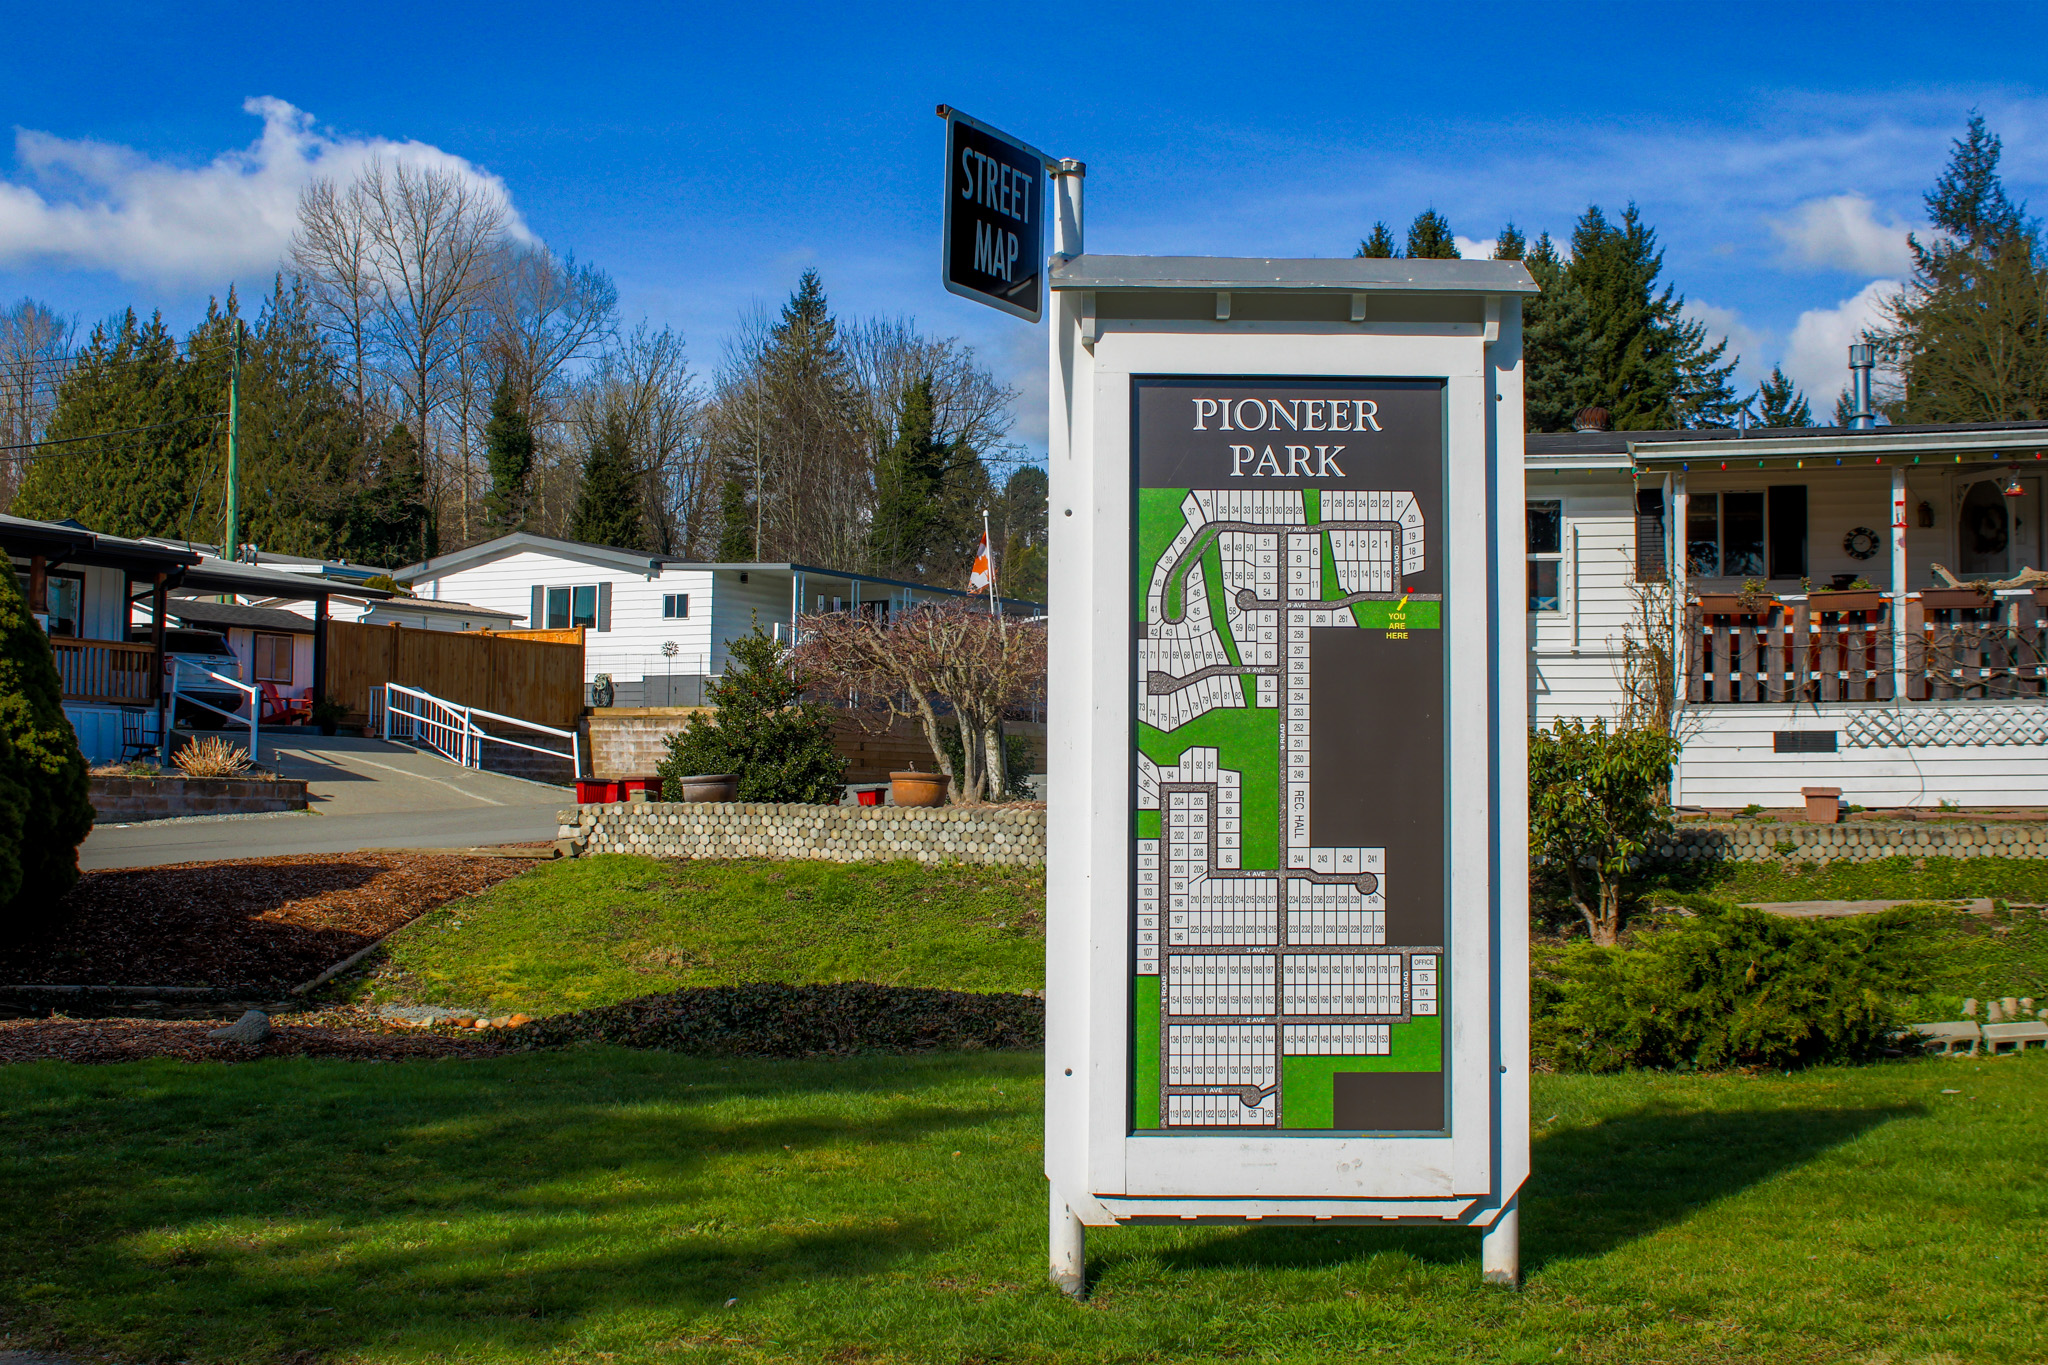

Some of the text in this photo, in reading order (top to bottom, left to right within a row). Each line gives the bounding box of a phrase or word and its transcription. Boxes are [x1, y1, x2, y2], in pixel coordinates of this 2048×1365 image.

[961, 146, 1033, 224] STREET
[973, 219, 1019, 283] MAP
[1192, 398, 1383, 432] PIONEER
[1228, 444, 1346, 478] PARK
[1202, 499, 1210, 507] 36
[1322, 500, 1330, 508] 27
[1334, 500, 1342, 508] 26
[1347, 500, 1354, 508] 25
[1370, 500, 1378, 508] 23
[1382, 500, 1390, 508] 22
[1396, 500, 1403, 508] 21
[1220, 506, 1227, 514] 35
[1231, 506, 1239, 514] 34
[1255, 506, 1263, 514] 32
[1265, 506, 1272, 514] 31
[1275, 506, 1282, 514] 30
[1409, 532, 1416, 540] 19
[1223, 544, 1231, 552] 48
[1246, 544, 1254, 552] 50
[1409, 547, 1416, 555] 18
[1165, 556, 1173, 564] 39
[1263, 555, 1271, 563] 52
[1296, 555, 1301, 563] 8
[1409, 562, 1416, 570] 17
[1191, 572, 1199, 580] 47
[1224, 572, 1231, 580] 57
[1246, 572, 1254, 580] 55
[1263, 572, 1271, 580] 53
[1296, 571, 1301, 579] 9
[1339, 570, 1346, 578] 12
[1350, 570, 1357, 578] 13
[1372, 570, 1379, 578] 15
[1383, 570, 1390, 578] 16
[1154, 579, 1161, 587] 40
[1295, 588, 1304, 596] 10
[1150, 605, 1158, 613] 41
[1229, 607, 1237, 615] 58
[1165, 628, 1173, 636] 43
[1294, 646, 1304, 654] 257
[1139, 651, 1146, 659] 72
[1150, 651, 1157, 659] 71
[1161, 651, 1169, 659] 70
[1206, 651, 1212, 659] 66
[1245, 651, 1253, 659] 64
[1264, 651, 1272, 659] 63
[1294, 677, 1304, 685] 255
[1224, 692, 1230, 700] 81
[1264, 695, 1271, 703] 84
[1192, 702, 1199, 710] 78
[1149, 709, 1156, 717] 74
[1181, 710, 1188, 718] 77
[1294, 708, 1304, 716] 253
[1294, 739, 1304, 747] 251
[1294, 755, 1304, 763] 250
[1183, 761, 1190, 769] 93
[1196, 761, 1203, 769] 92
[1207, 761, 1214, 769] 91
[1167, 771, 1174, 779] 94
[1225, 775, 1233, 784] 90
[1225, 791, 1233, 799] 89
[1143, 797, 1150, 805] 97
[1174, 797, 1184, 805] 204
[1193, 797, 1204, 805] 205
[1225, 806, 1233, 814] 88
[1294, 790, 1304, 839] REC. HALL
[1174, 831, 1184, 839] 202
[1193, 831, 1204, 839] 207
[1225, 837, 1233, 845] 86
[1144, 843, 1152, 851] 100
[1174, 848, 1184, 856] 201
[1193, 848, 1204, 856] 208
[1225, 855, 1233, 863] 85
[1294, 855, 1304, 863] 244
[1318, 855, 1328, 863] 243
[1342, 855, 1353, 863] 242
[1368, 855, 1377, 863] 241
[1174, 865, 1184, 873] 200
[1144, 873, 1152, 881] 102
[1368, 895, 1378, 903] 240
[1144, 903, 1152, 911] 104
[1143, 948, 1152, 956] 107
[1414, 958, 1434, 966] OFFICE
[1390, 966, 1399, 974] 177
[1419, 974, 1428, 982] 175
[1419, 988, 1428, 996] 174
[1391, 996, 1400, 1004] 172
[1308, 1035, 1317, 1043] 147
[1379, 1035, 1388, 1043] 153
[1265, 1066, 1273, 1074] 127
[1170, 1110, 1179, 1118] 119
[1206, 1110, 1214, 1118] 122
[1248, 1110, 1257, 1118] 125
